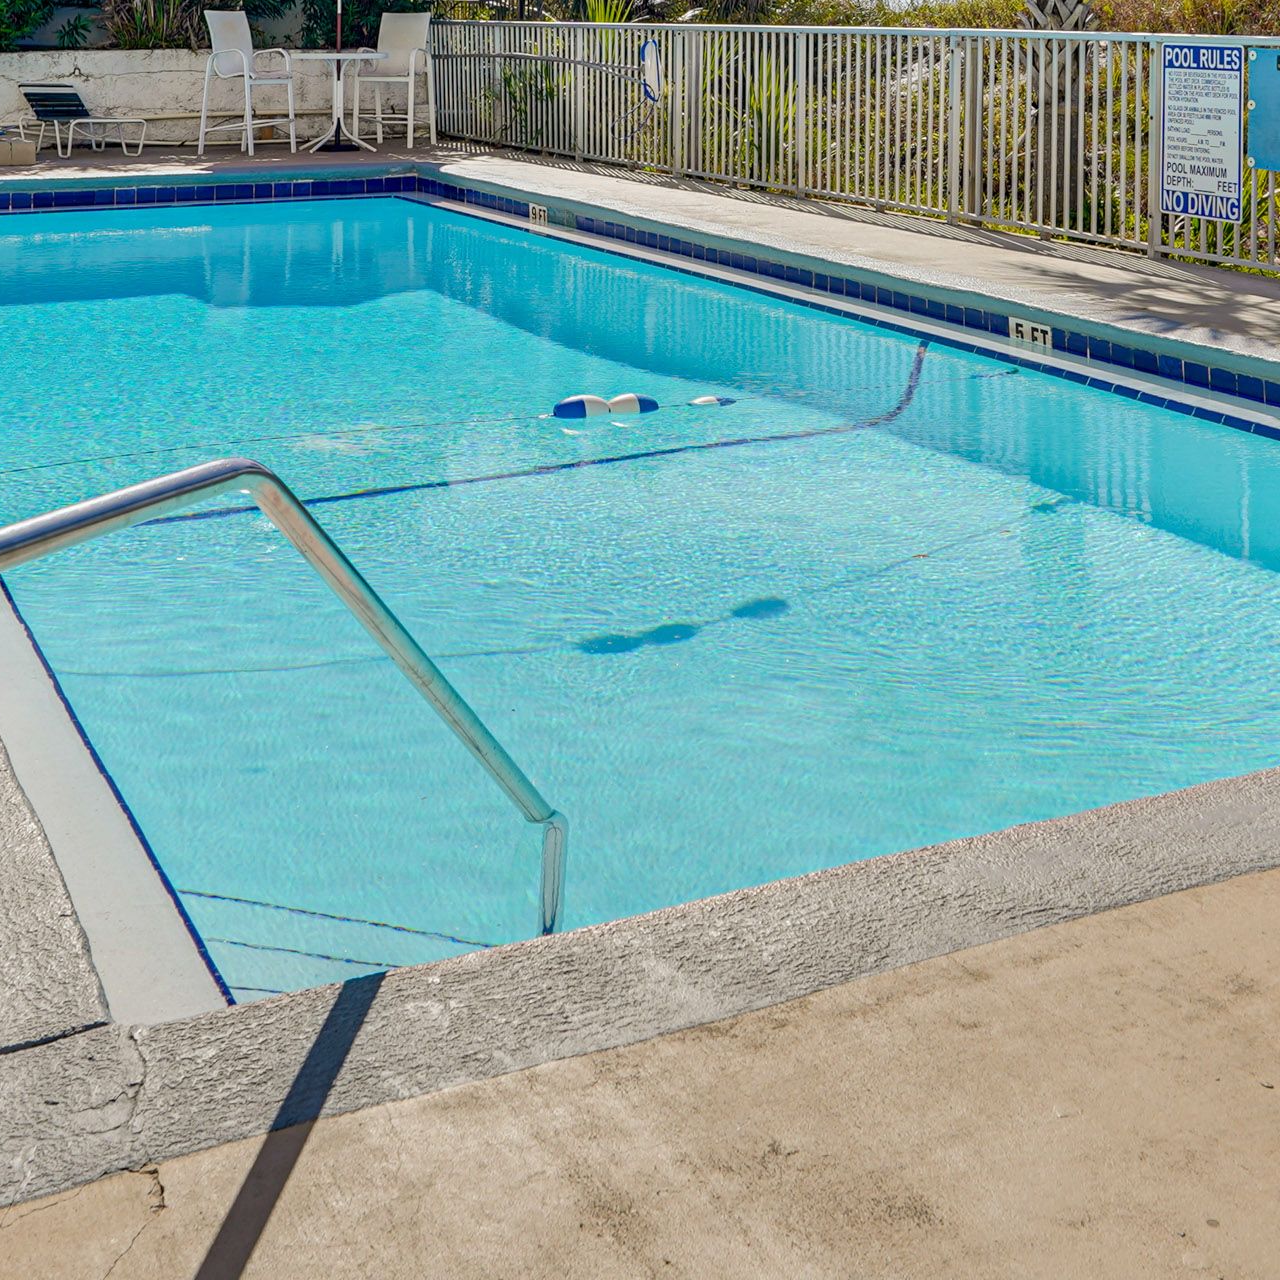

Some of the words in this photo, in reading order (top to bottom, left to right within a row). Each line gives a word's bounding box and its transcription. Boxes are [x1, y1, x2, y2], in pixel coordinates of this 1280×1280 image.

[1165, 47, 1197, 68] POOL
[1200, 48, 1240, 70] RULES
[1166, 162, 1187, 174] POOL
[1190, 164, 1227, 178] MAXIMUM
[1166, 175, 1194, 188] DEPTH:
[1217, 181, 1238, 193] FEET
[531, 206, 536, 219] 9
[538, 208, 546, 221] FT
[1163, 190, 1184, 212] NO
[1187, 193, 1239, 220] DIVING
[1015, 322, 1024, 339] 5
[1031, 326, 1049, 345] FT
